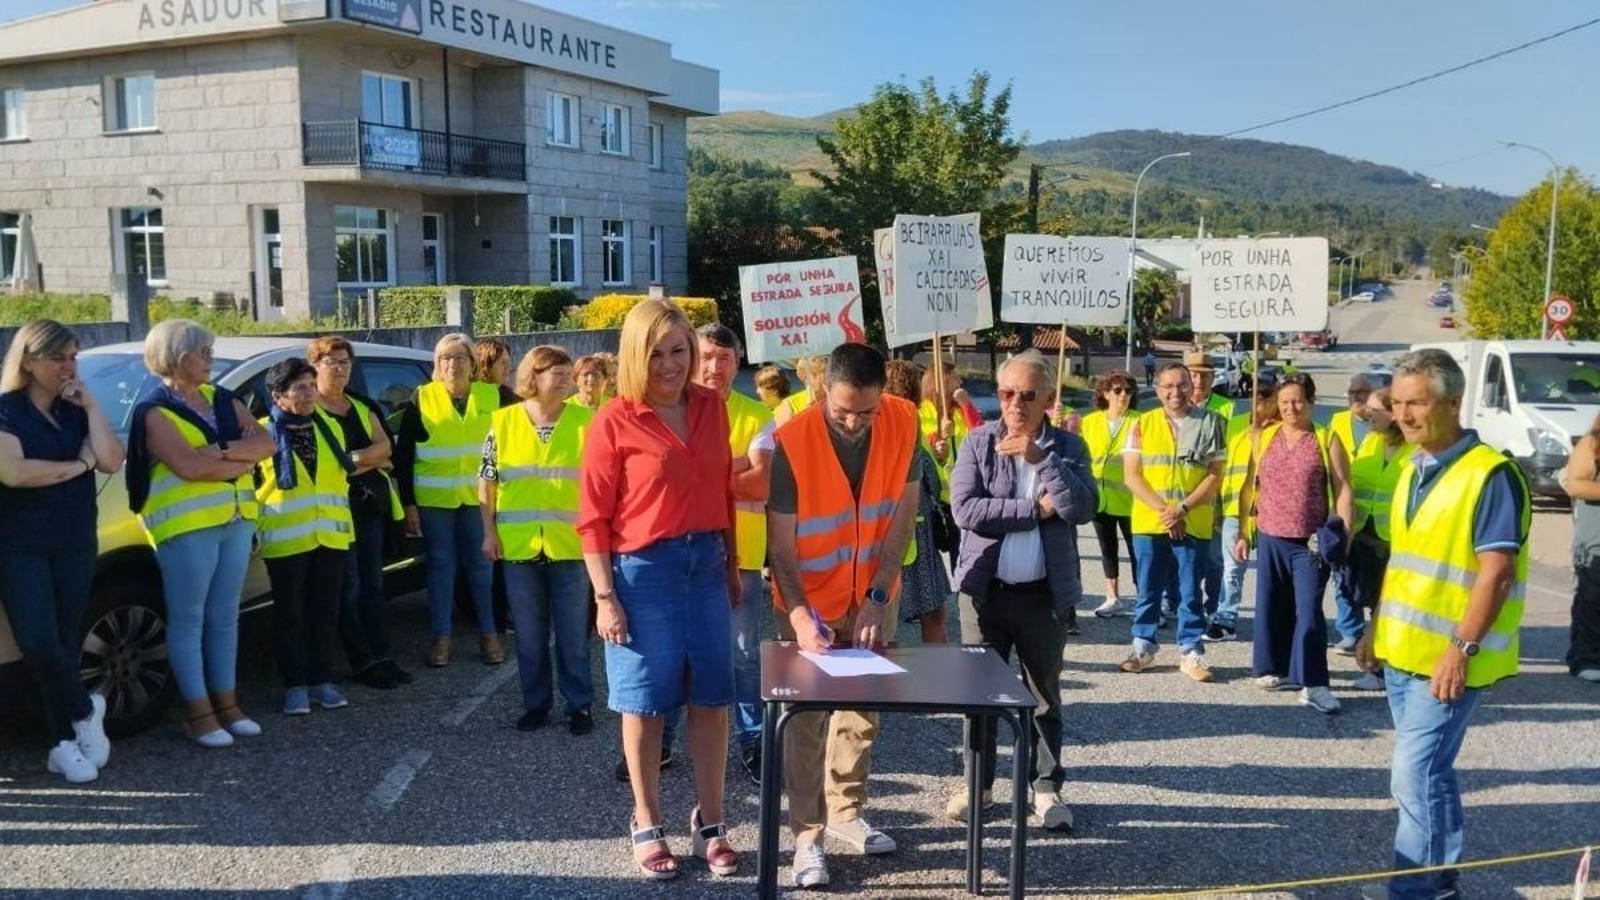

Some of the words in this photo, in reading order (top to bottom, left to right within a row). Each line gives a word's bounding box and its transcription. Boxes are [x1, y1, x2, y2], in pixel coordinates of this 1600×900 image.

[138, 0, 266, 30] ASADOR
[429, 0, 617, 69] RESTAURANTE
[1014, 246, 1105, 263] QUEREMOS
[1201, 250, 1233, 267] POR
[1247, 248, 1292, 267] UNHA
[766, 273, 792, 285] POR
[799, 268, 835, 281] UNHA
[916, 269, 977, 290] CACICADAS
[1213, 273, 1293, 293] ESTRADA
[751, 288, 802, 302] ESTRADA
[1214, 298, 1296, 319] SEGURA
[1551, 305, 1569, 316] 30
[754, 309, 832, 332] SOLUCIÓN
